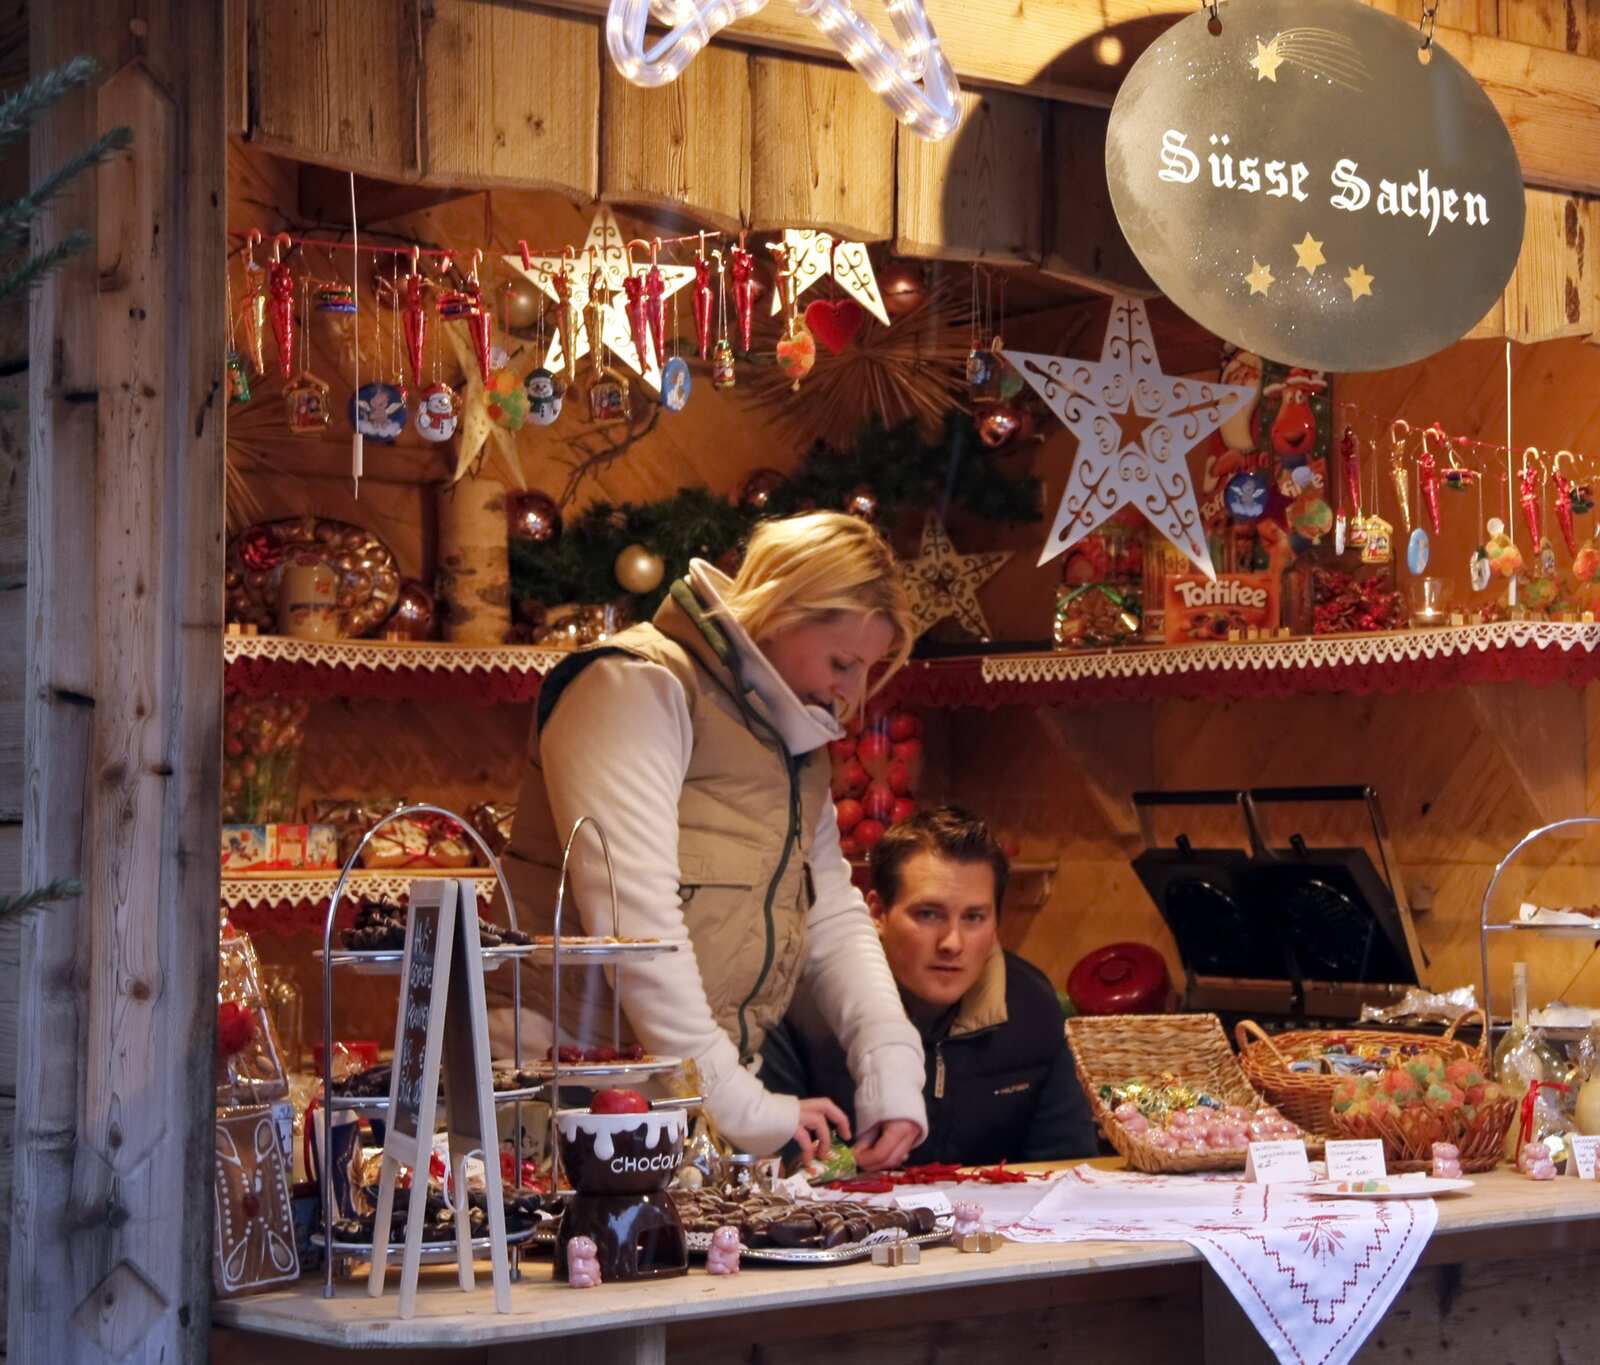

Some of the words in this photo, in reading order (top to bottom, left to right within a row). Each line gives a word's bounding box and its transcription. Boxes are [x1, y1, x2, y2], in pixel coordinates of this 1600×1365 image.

[1157, 128, 1310, 202] Süsse
[1329, 158, 1491, 237] Sachen
[1174, 579, 1268, 609] Toffifee
